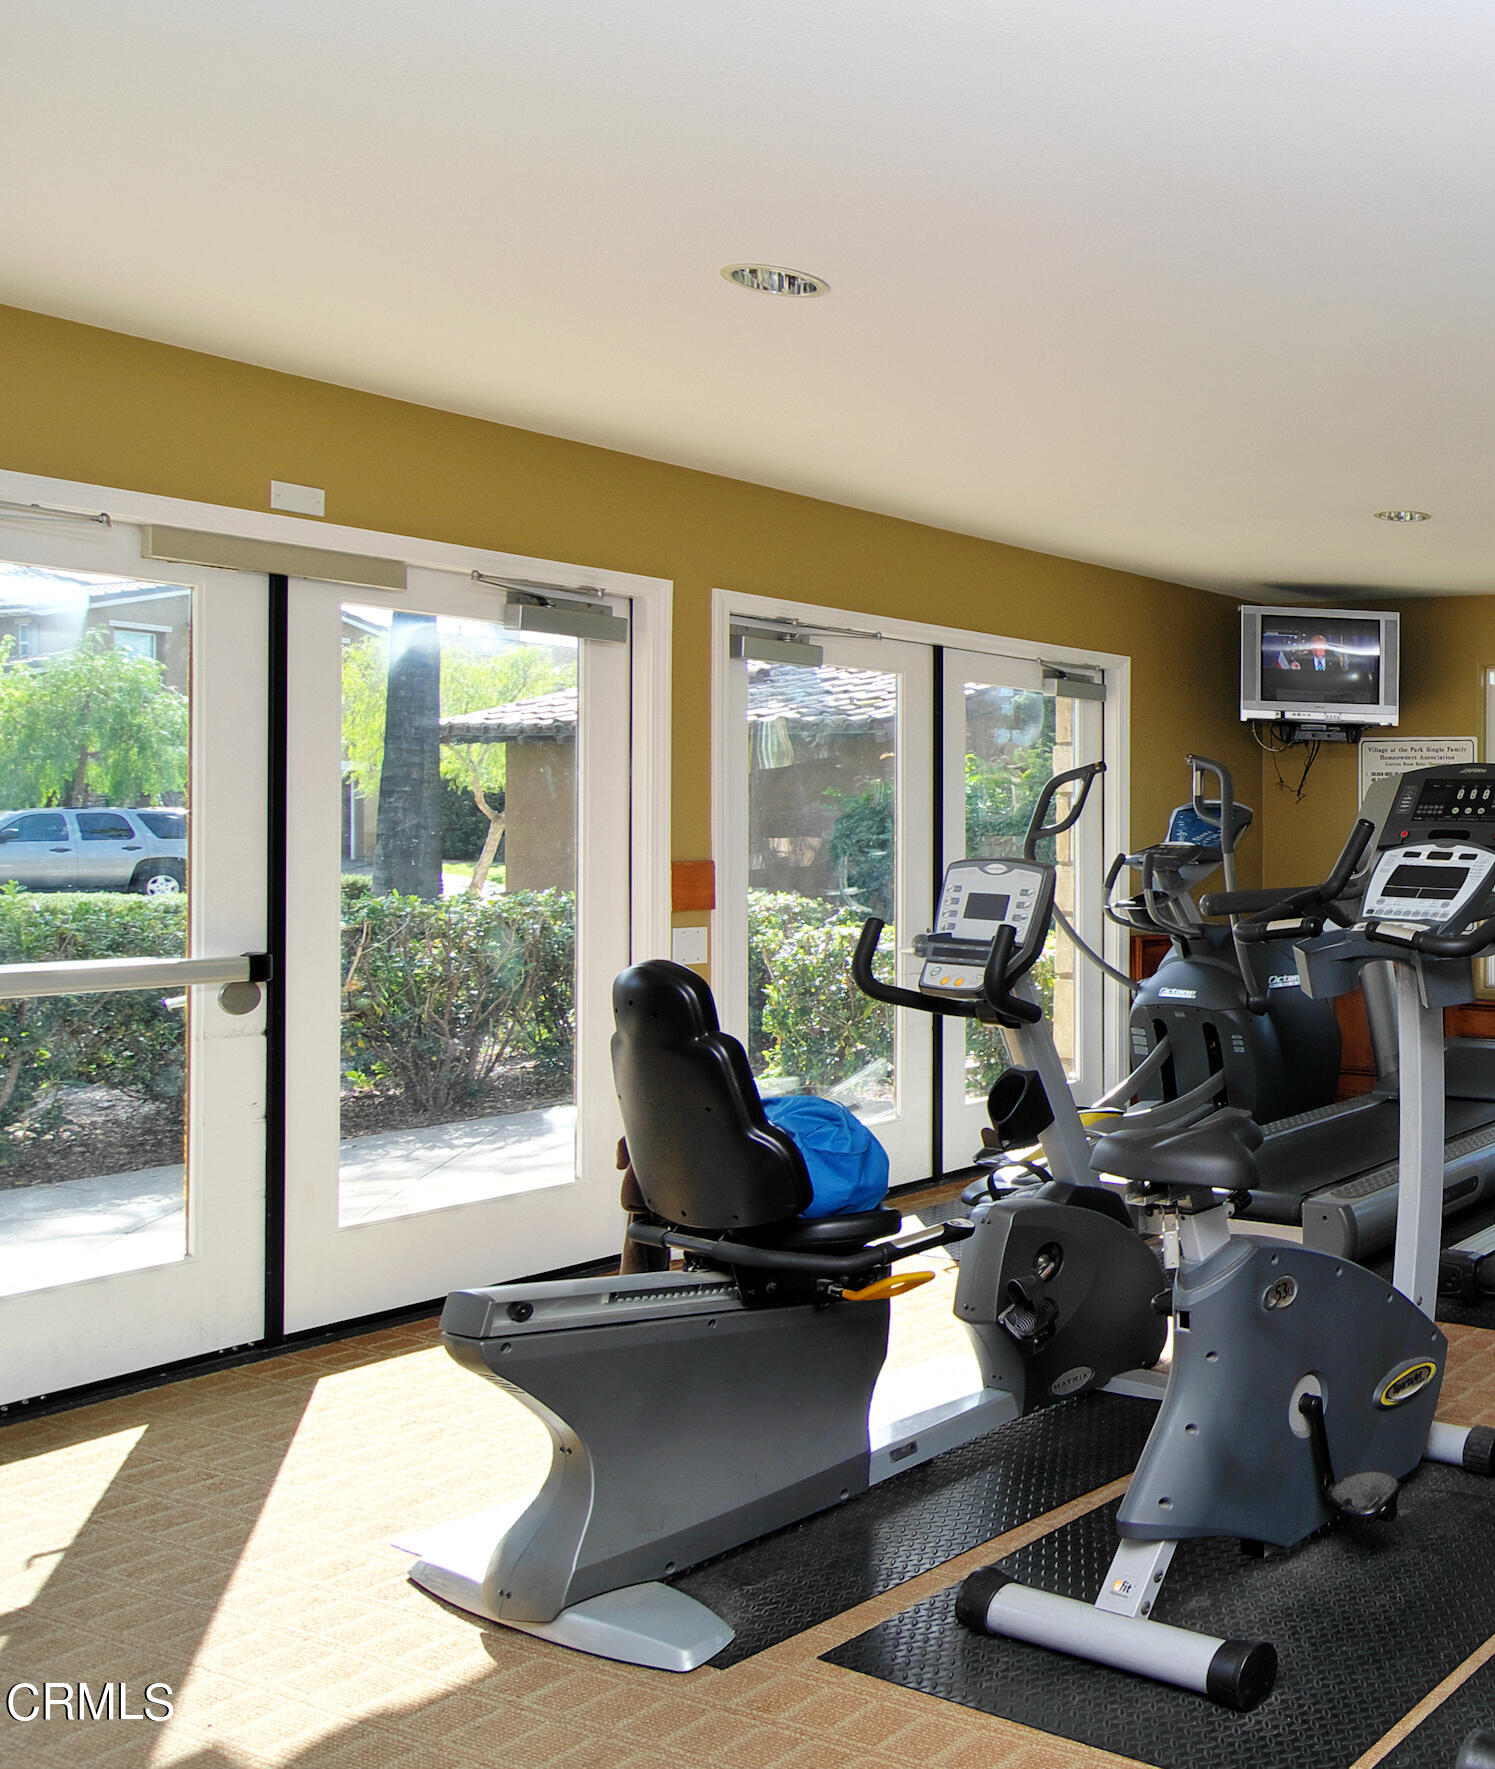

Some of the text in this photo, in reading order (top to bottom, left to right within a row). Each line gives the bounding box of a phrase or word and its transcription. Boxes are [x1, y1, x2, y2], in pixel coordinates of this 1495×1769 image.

[1159, 987, 1197, 995] Octane
[1053, 1372, 1088, 1390] MATRIX
[1392, 1370, 1424, 1394] SportsArt
